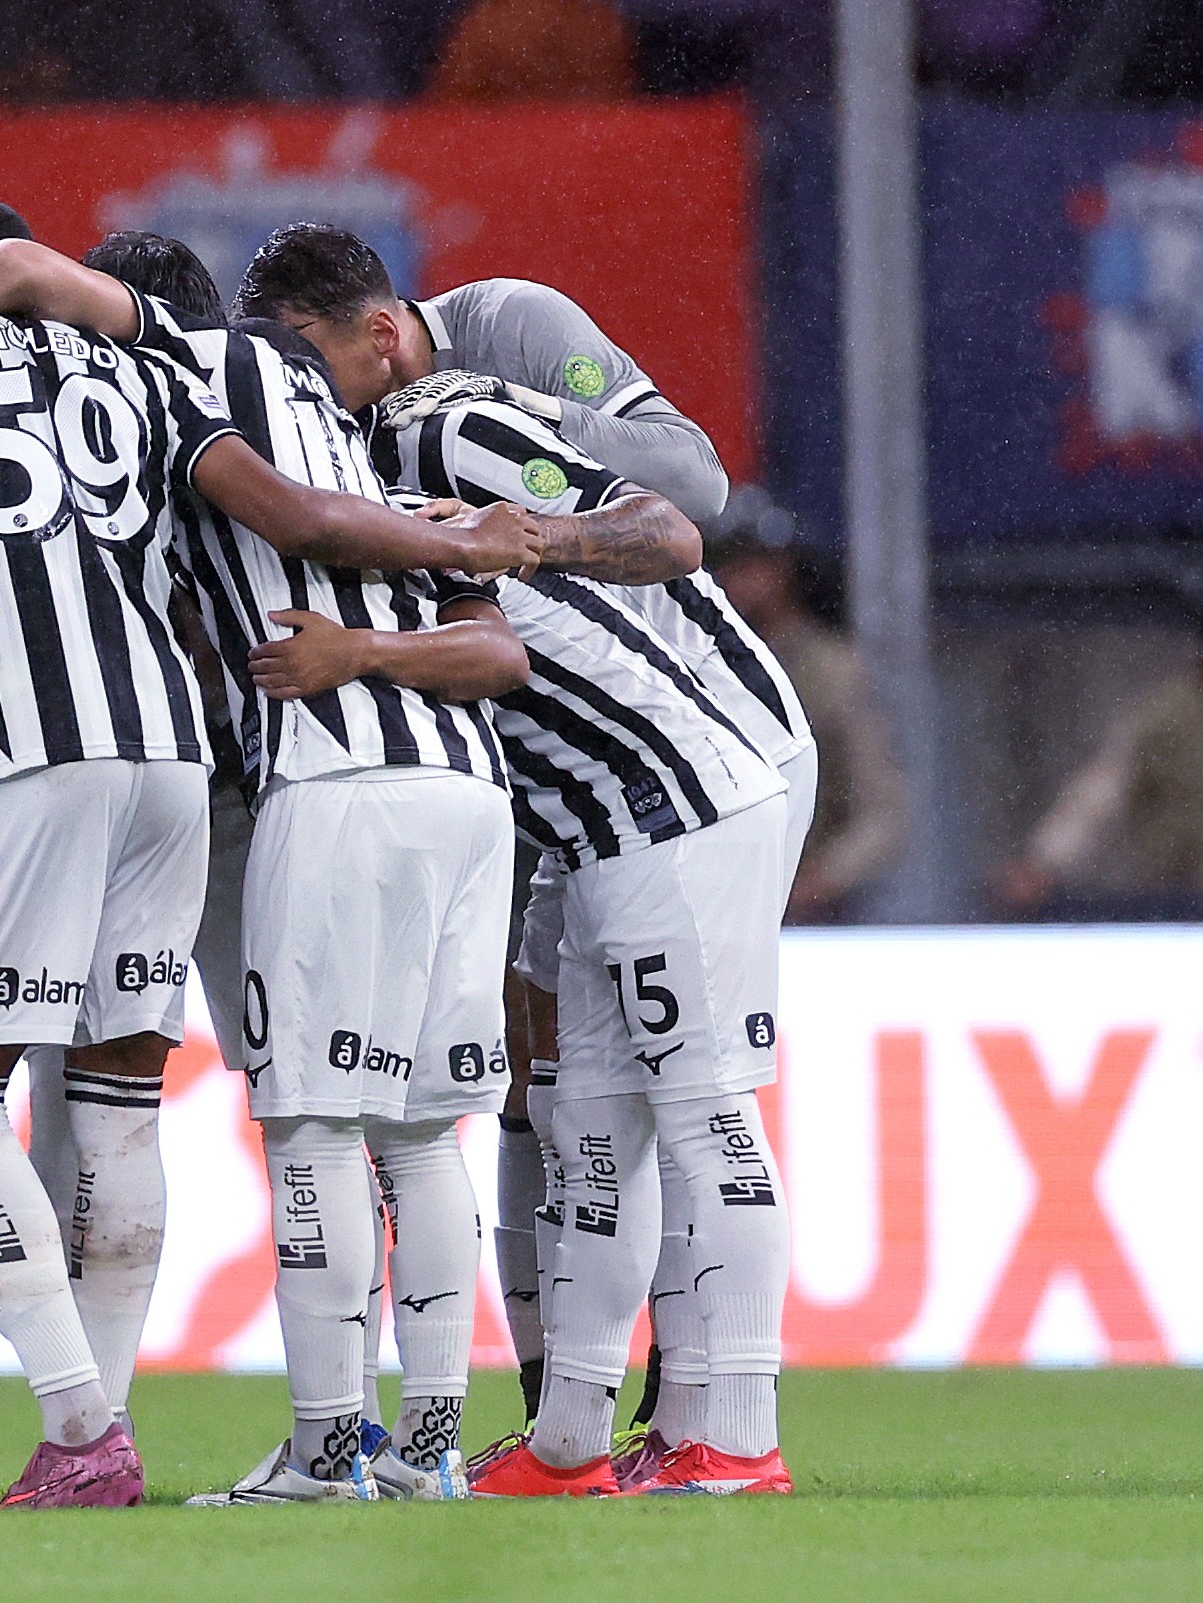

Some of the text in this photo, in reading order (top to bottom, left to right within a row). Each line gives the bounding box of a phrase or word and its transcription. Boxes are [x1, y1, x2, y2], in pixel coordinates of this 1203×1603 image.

[149, 949, 187, 986] ála
[606, 951, 679, 1039] 15
[580, 1133, 619, 1210] Lifefit
[708, 1110, 770, 1185] Lifefit
[284, 1164, 324, 1242] Lifefit
